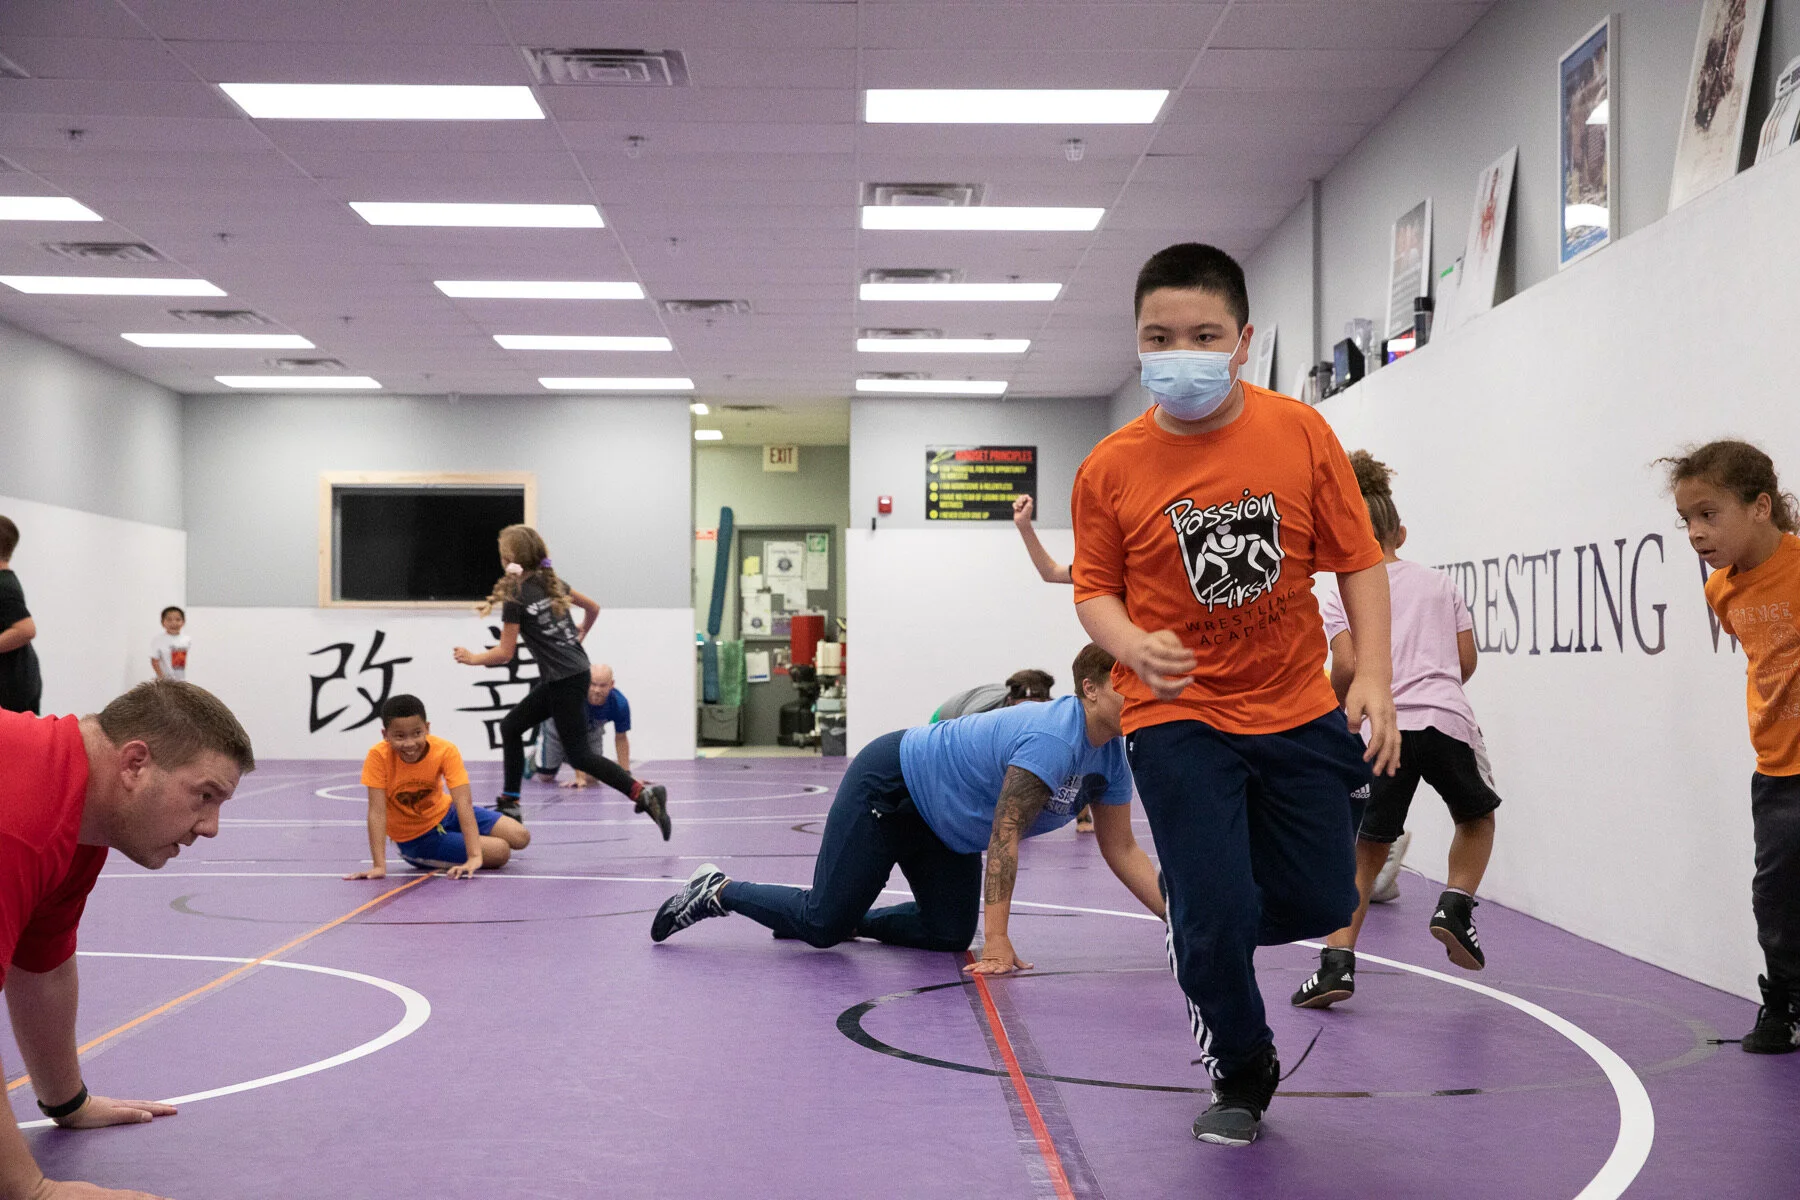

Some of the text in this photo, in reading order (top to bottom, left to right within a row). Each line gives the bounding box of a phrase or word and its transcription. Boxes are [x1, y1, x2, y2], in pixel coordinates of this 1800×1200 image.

[769, 447, 793, 464] EXIT
[990, 450, 1032, 461] PRINCIPLES
[1164, 489, 1281, 535] Passion
[1185, 587, 1296, 632] WRESTLING
[1201, 568, 1277, 613] First
[1430, 532, 1668, 656] RESTLING
[1200, 606, 1287, 646] ACADEMY
